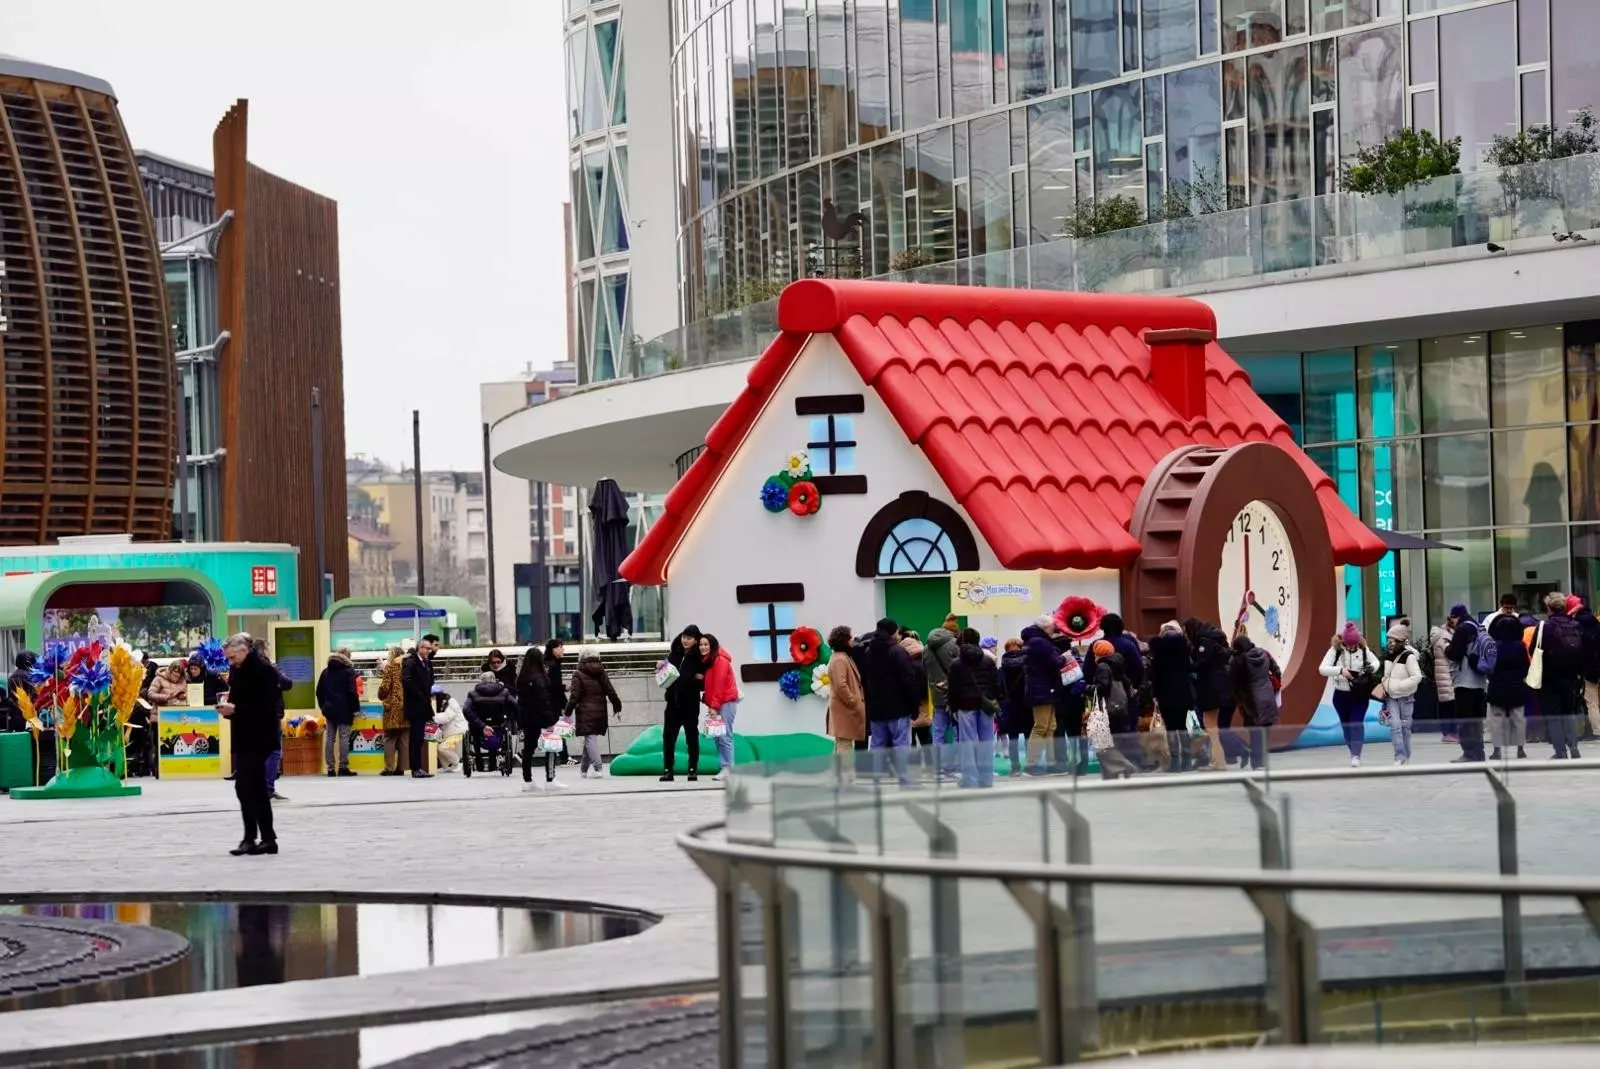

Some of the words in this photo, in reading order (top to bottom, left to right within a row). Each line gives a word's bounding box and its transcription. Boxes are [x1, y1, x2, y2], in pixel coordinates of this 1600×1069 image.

[1239, 513, 1251, 532] 12
[1259, 525, 1265, 545] 1
[1272, 551, 1280, 570] 2
[1279, 586, 1285, 606] 3
